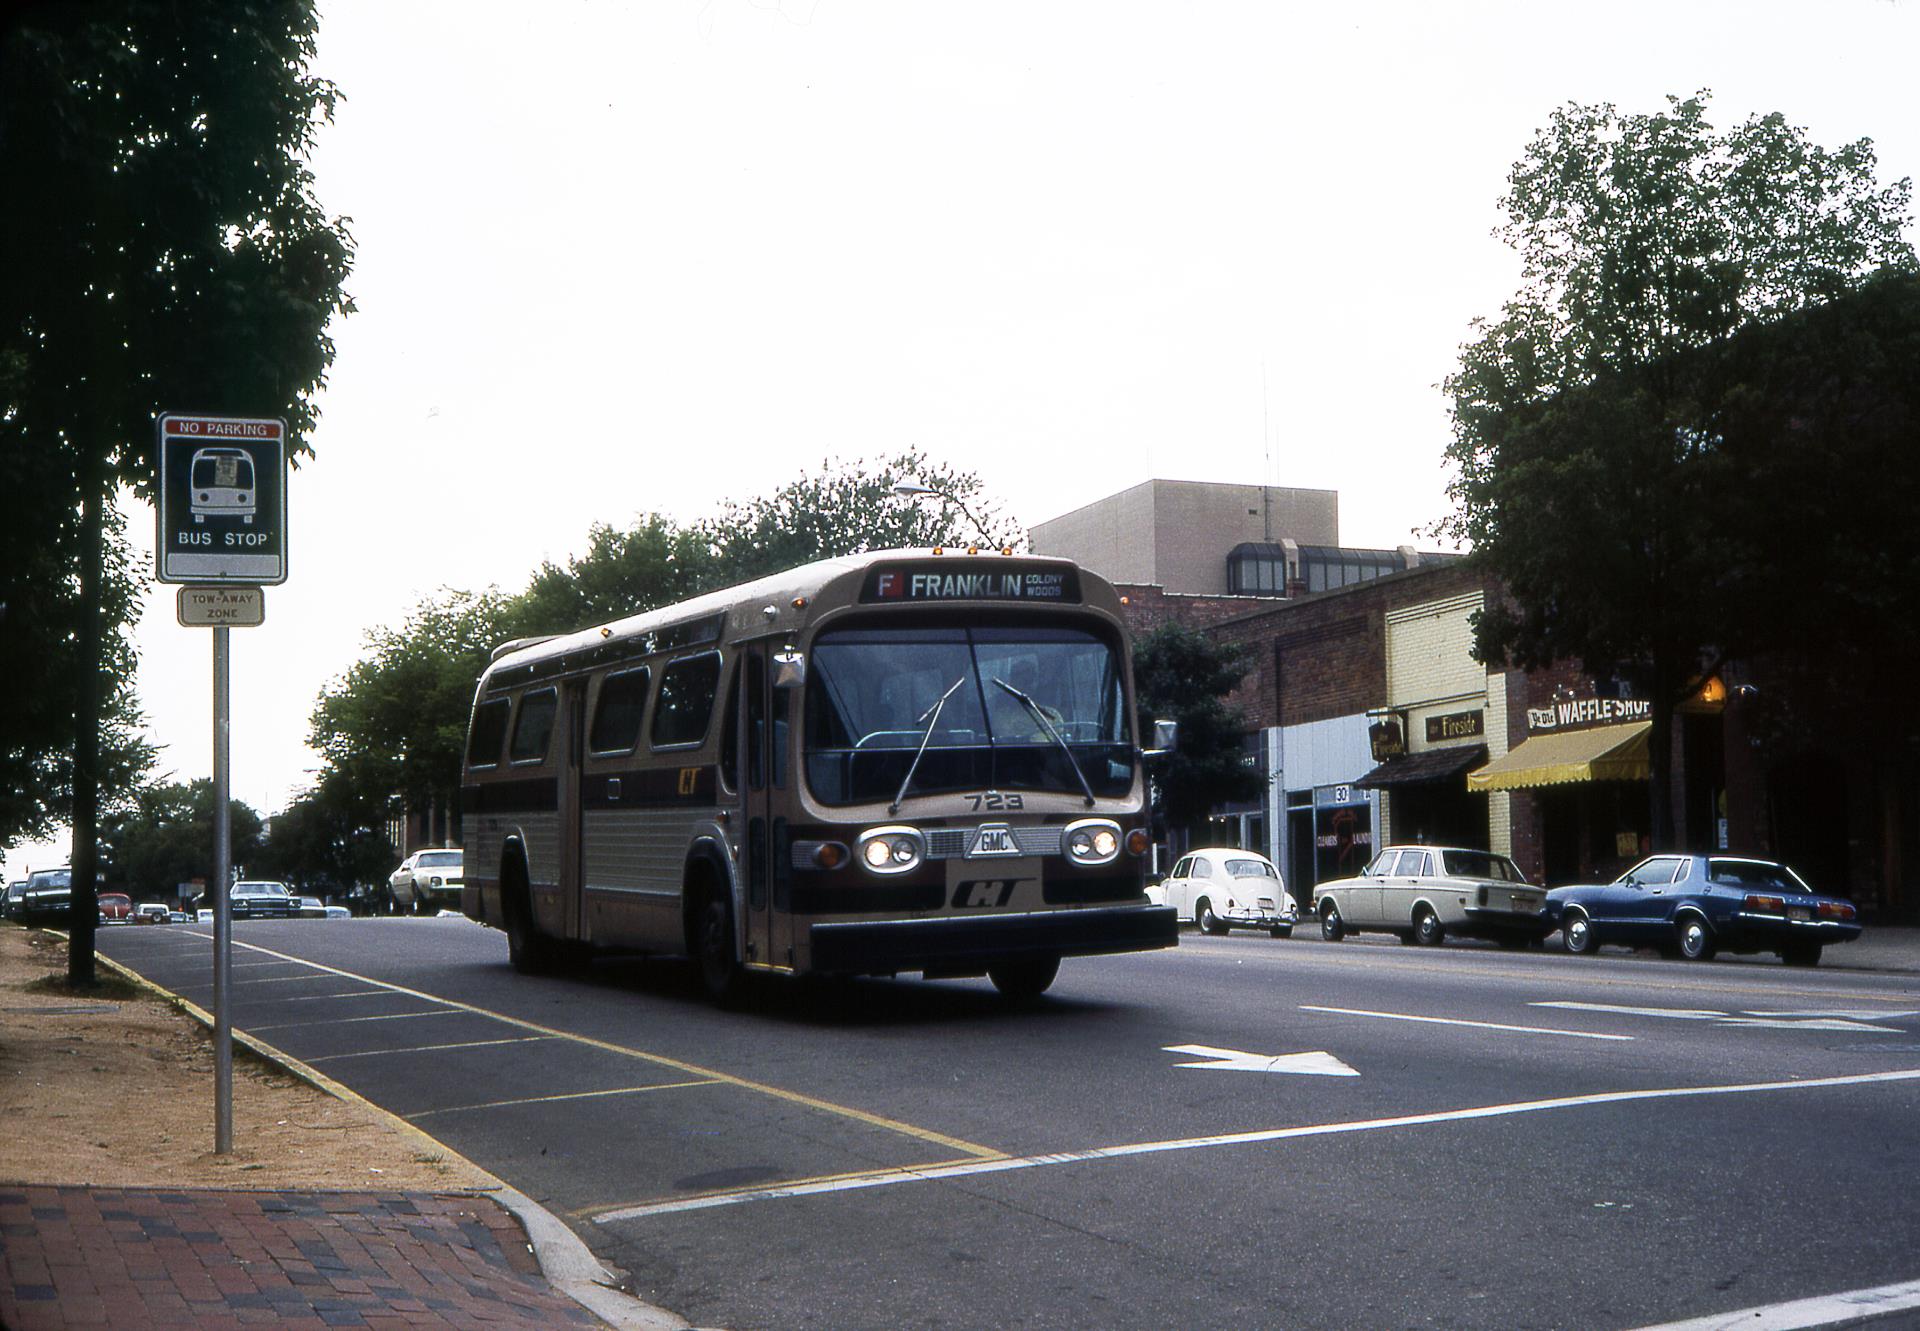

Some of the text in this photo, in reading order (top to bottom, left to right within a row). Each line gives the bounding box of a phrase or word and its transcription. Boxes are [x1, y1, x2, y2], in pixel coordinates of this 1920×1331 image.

[179, 422, 267, 436] NO PARKING
[178, 532, 268, 546] BUS STOP
[878, 574, 1021, 597] F FRANKLIN
[1025, 574, 1063, 585] COLONY
[1027, 586, 1062, 596] WOODS
[192, 593, 253, 604] TOW-AWAY
[207, 609, 238, 618] ZONE
[1558, 698, 1612, 724] WAFFLE
[964, 794, 1024, 811] 723
[981, 832, 1009, 851] GMC
